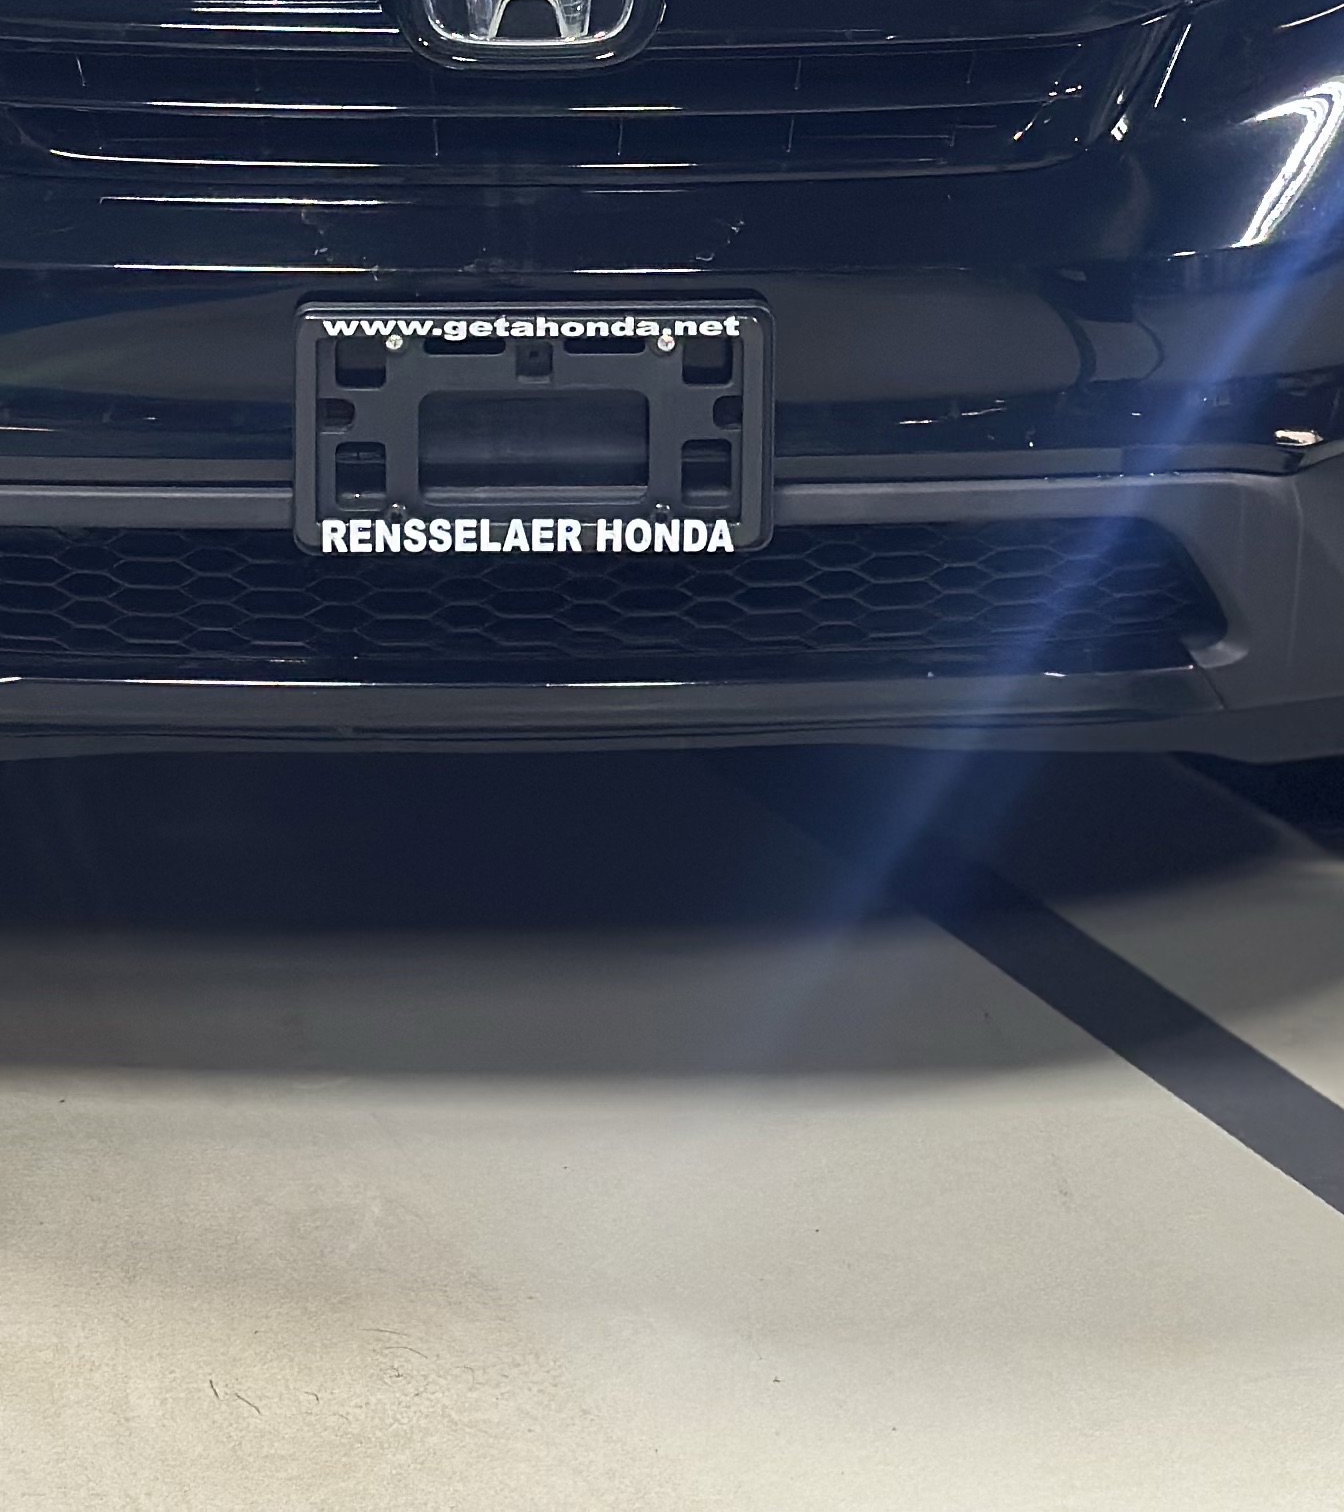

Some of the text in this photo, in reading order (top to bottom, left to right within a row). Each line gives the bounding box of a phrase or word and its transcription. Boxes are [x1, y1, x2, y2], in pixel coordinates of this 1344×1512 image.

[322, 316, 741, 341] www.getahonda.net
[321, 518, 735, 553] RENSSELAER HONDA
